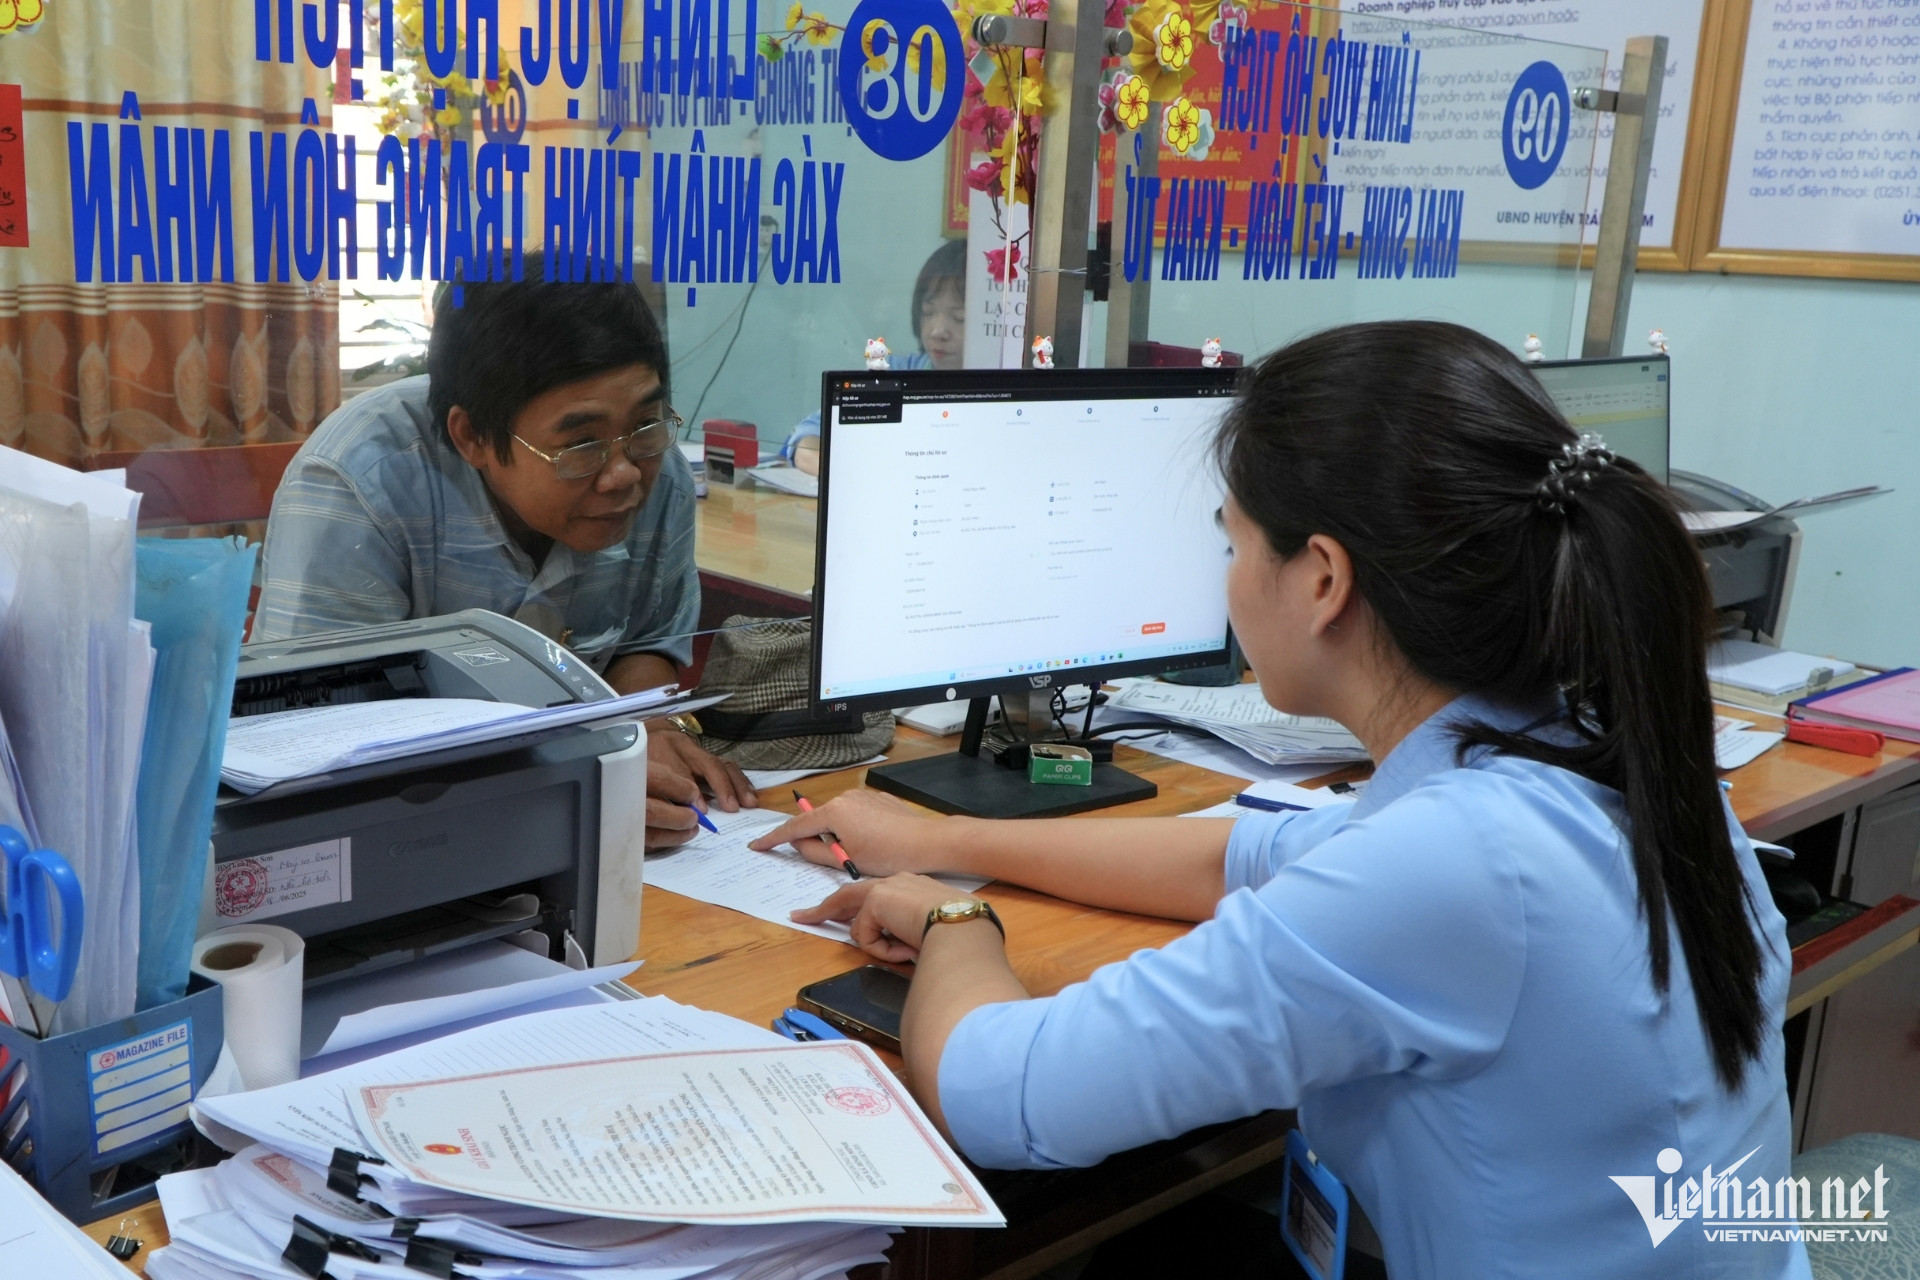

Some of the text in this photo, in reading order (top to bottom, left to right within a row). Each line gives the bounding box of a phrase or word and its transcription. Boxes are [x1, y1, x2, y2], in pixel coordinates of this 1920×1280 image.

[1358, 2, 1394, 13] Doanh
[1773, 19, 1812, 33] thông
[1816, 19, 1832, 31] tin
[1793, 37, 1838, 51] Không
[1497, 209, 1575, 228] UBND HUYỆN
[1029, 675, 1052, 689] VSP
[833, 703, 847, 712] IPS
[116, 1027, 186, 1061] MAGAZINE FILE
